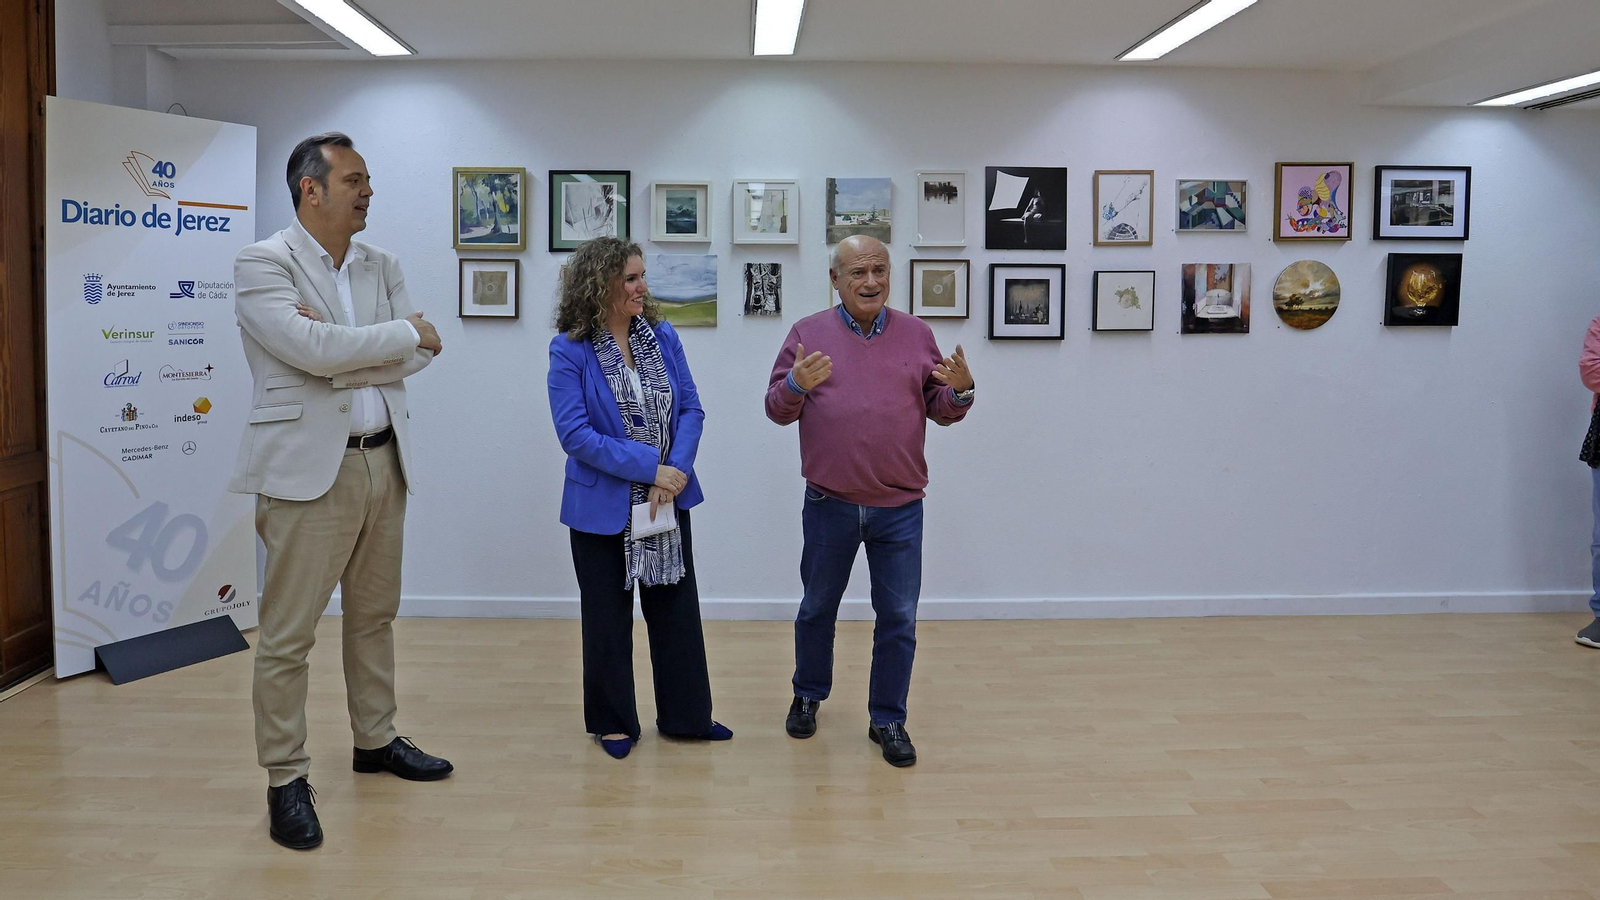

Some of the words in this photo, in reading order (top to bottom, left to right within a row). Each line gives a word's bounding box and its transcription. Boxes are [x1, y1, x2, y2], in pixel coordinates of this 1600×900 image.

[151, 161, 176, 179] 40
[152, 180, 175, 188] AÑOS
[61, 199, 136, 227] Diario
[141, 204, 172, 229] de
[175, 207, 231, 236] Jerez
[107, 283, 156, 291] Ayuntamiento
[197, 280, 234, 290] Diputación
[117, 290, 136, 298] Jerez
[208, 291, 228, 299] Cádiz
[101, 324, 155, 340] Verinsur
[168, 338, 204, 346] SANICOR
[103, 371, 142, 386] Carrod
[162, 370, 208, 379] MONTESIERRA
[174, 414, 202, 423] indeso
[99, 426, 128, 434] CAYETANO
[121, 444, 169, 454] Mercedes-Benz
[121, 453, 153, 462] CADIMAR
[105, 500, 209, 583] 40
[77, 580, 174, 624] AÑOS
